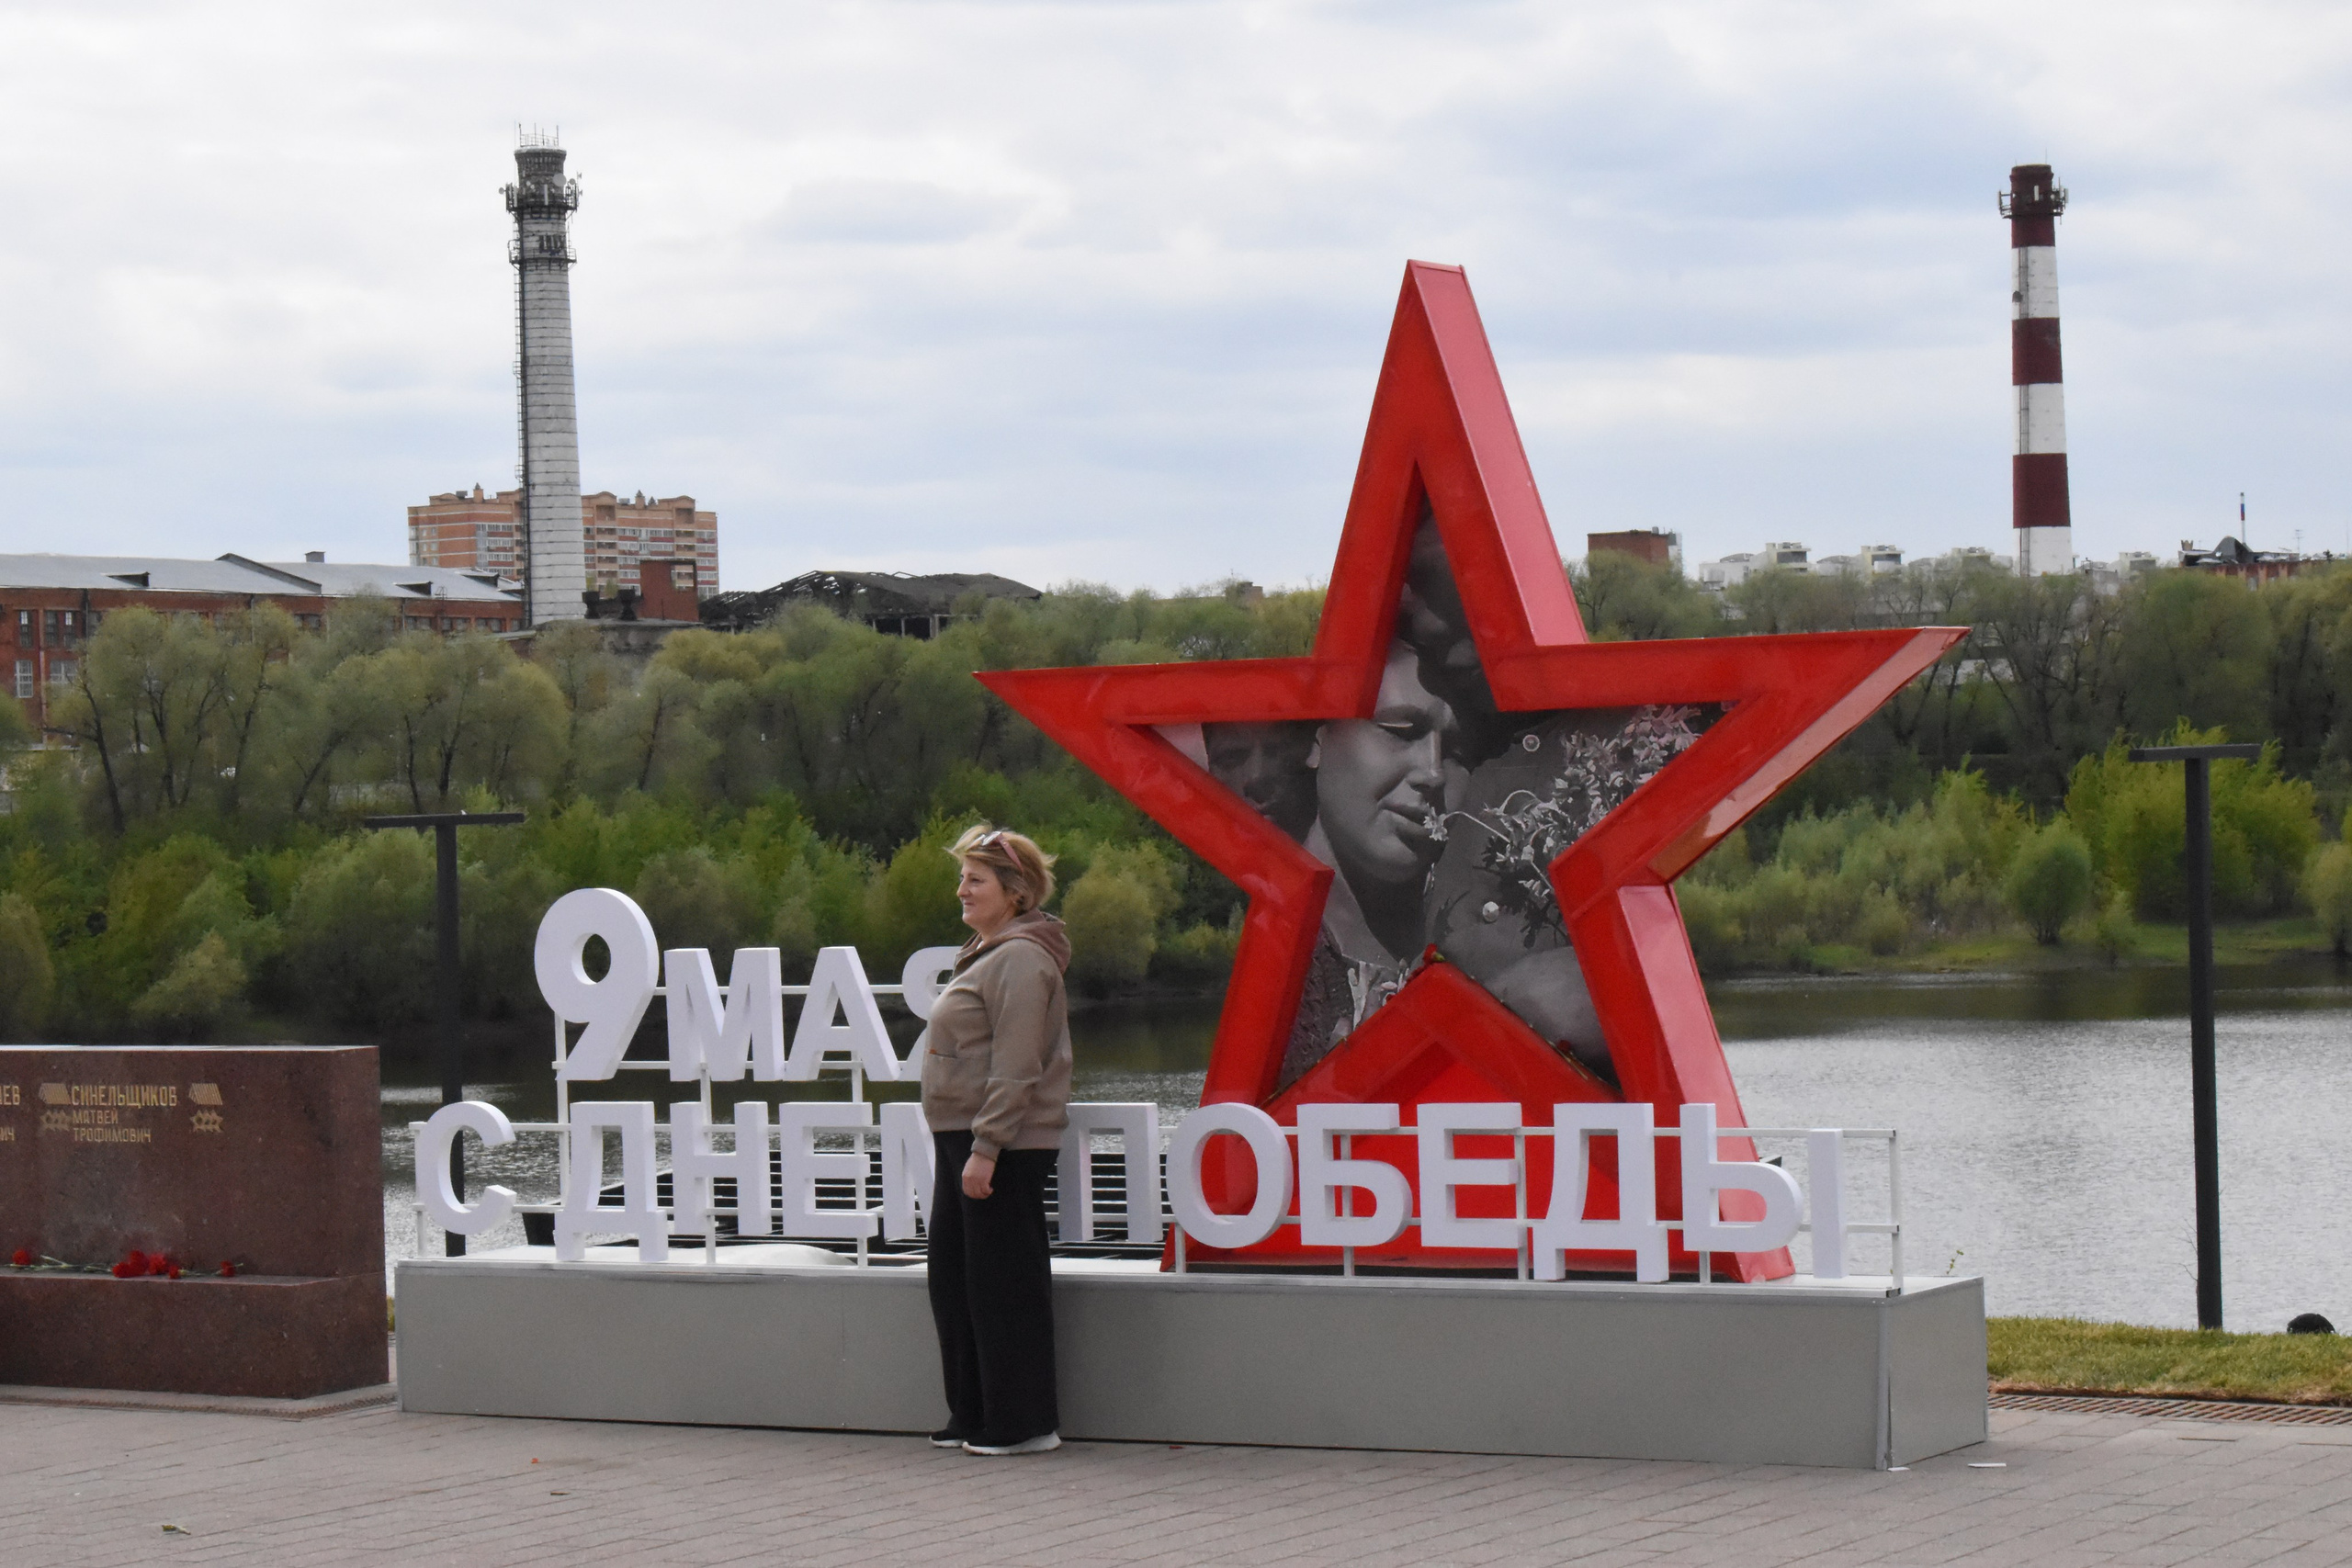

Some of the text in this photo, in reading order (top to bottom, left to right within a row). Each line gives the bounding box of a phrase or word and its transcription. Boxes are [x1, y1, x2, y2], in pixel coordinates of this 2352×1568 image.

[534, 888, 659, 1080] 9
[71, 1085, 177, 1109] СИНЕЛЬЩИКОВ
[73, 1108, 119, 1124] МАТВЕЙ
[74, 1127, 152, 1143] ТРОФИМОВИЧ
[415, 1101, 516, 1235] С
[1057, 1101, 1849, 1283] ПОБЕДЫ
